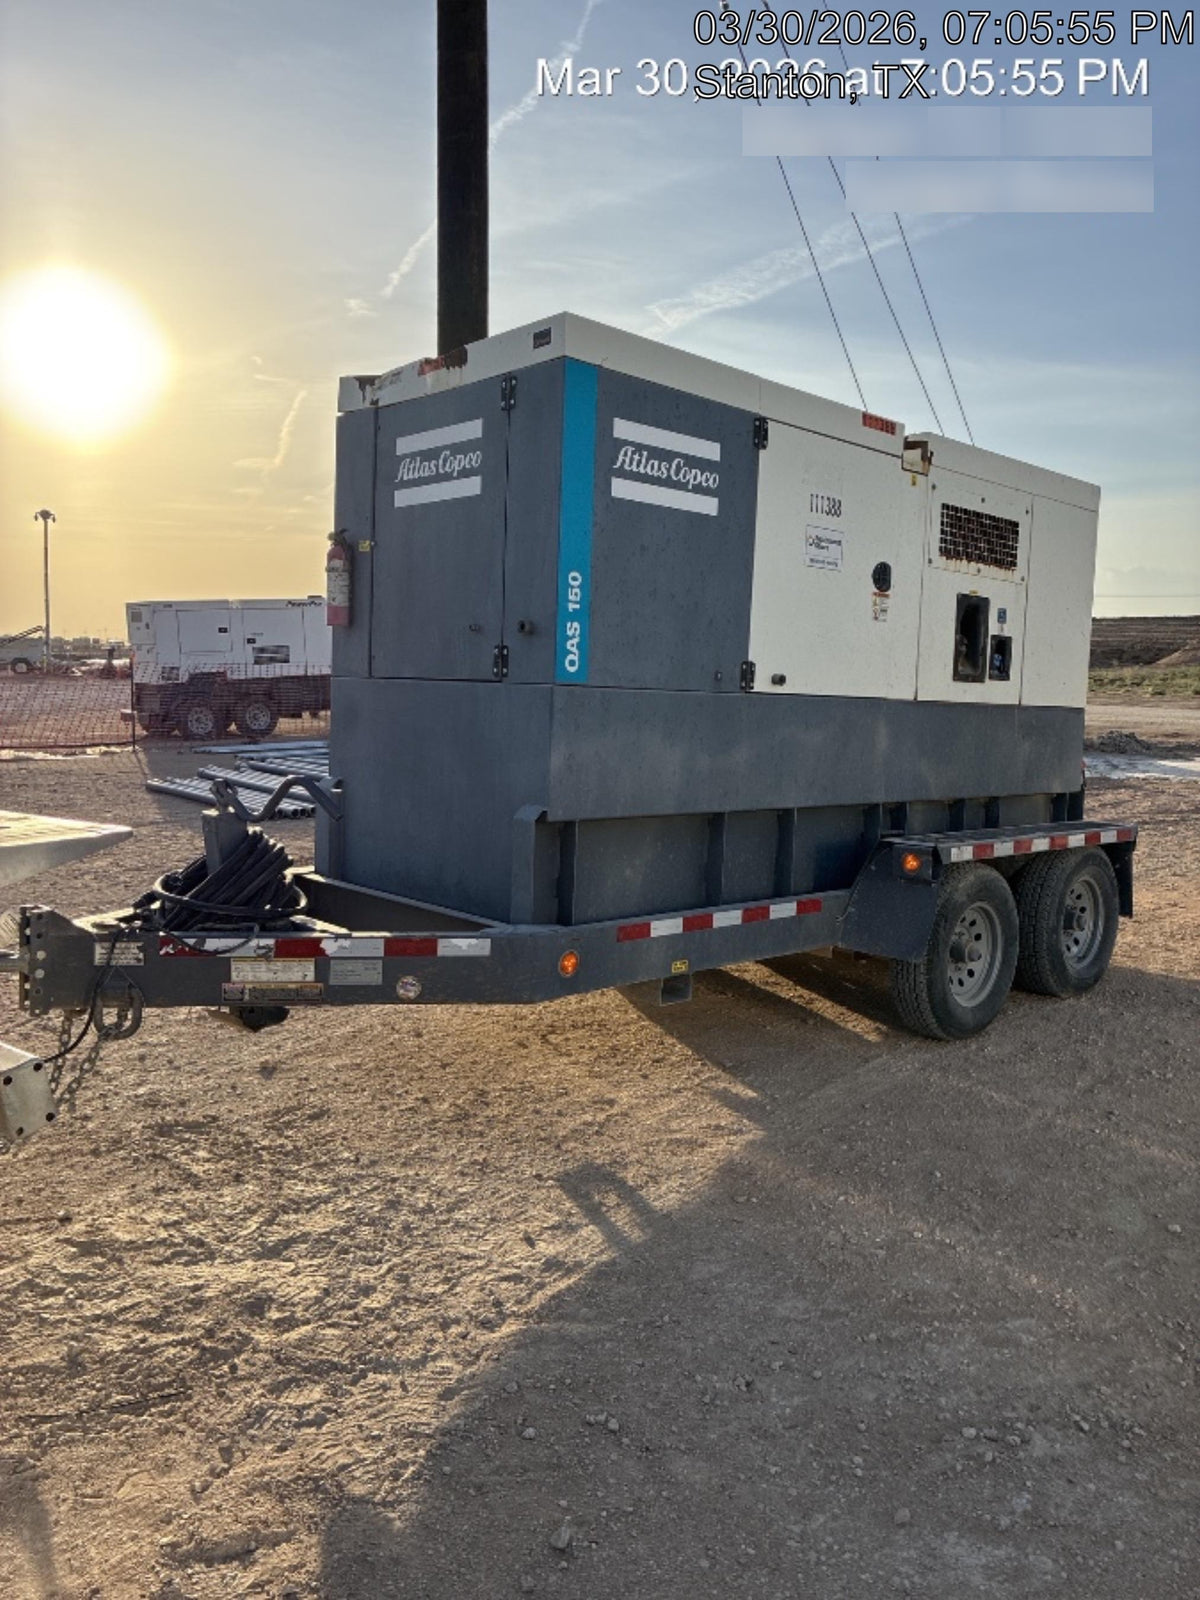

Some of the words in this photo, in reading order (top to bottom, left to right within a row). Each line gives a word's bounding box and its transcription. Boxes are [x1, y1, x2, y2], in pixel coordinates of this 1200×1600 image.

[394, 456, 437, 482] Atlas
[438, 450, 482, 477] Copco
[612, 445, 669, 479] Atlas
[669, 457, 719, 489] Copco
[568, 571, 582, 612] 150
